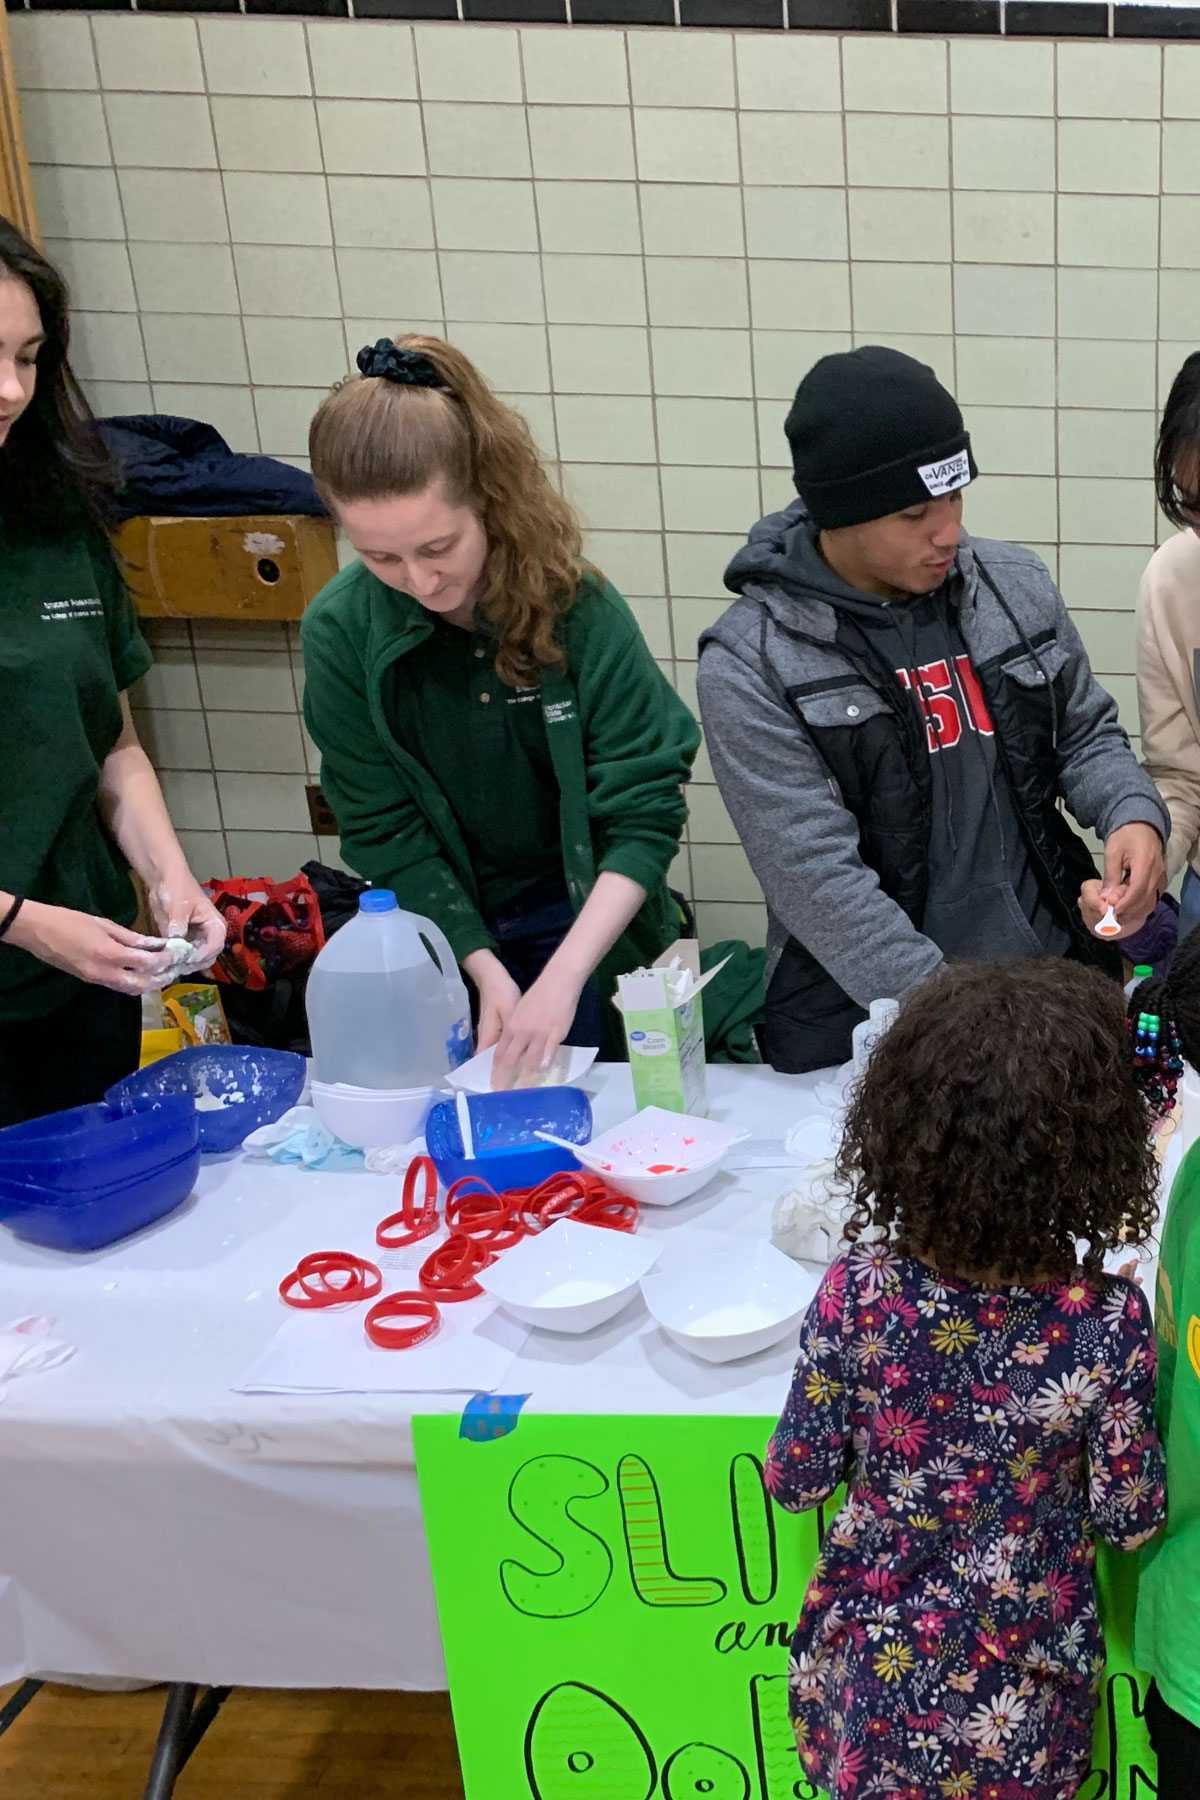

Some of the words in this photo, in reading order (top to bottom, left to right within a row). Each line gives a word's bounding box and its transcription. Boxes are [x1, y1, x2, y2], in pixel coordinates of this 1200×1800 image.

[932, 456, 963, 479] VANS
[500, 1452, 780, 1618] SLI
[714, 1621, 796, 1653] an
